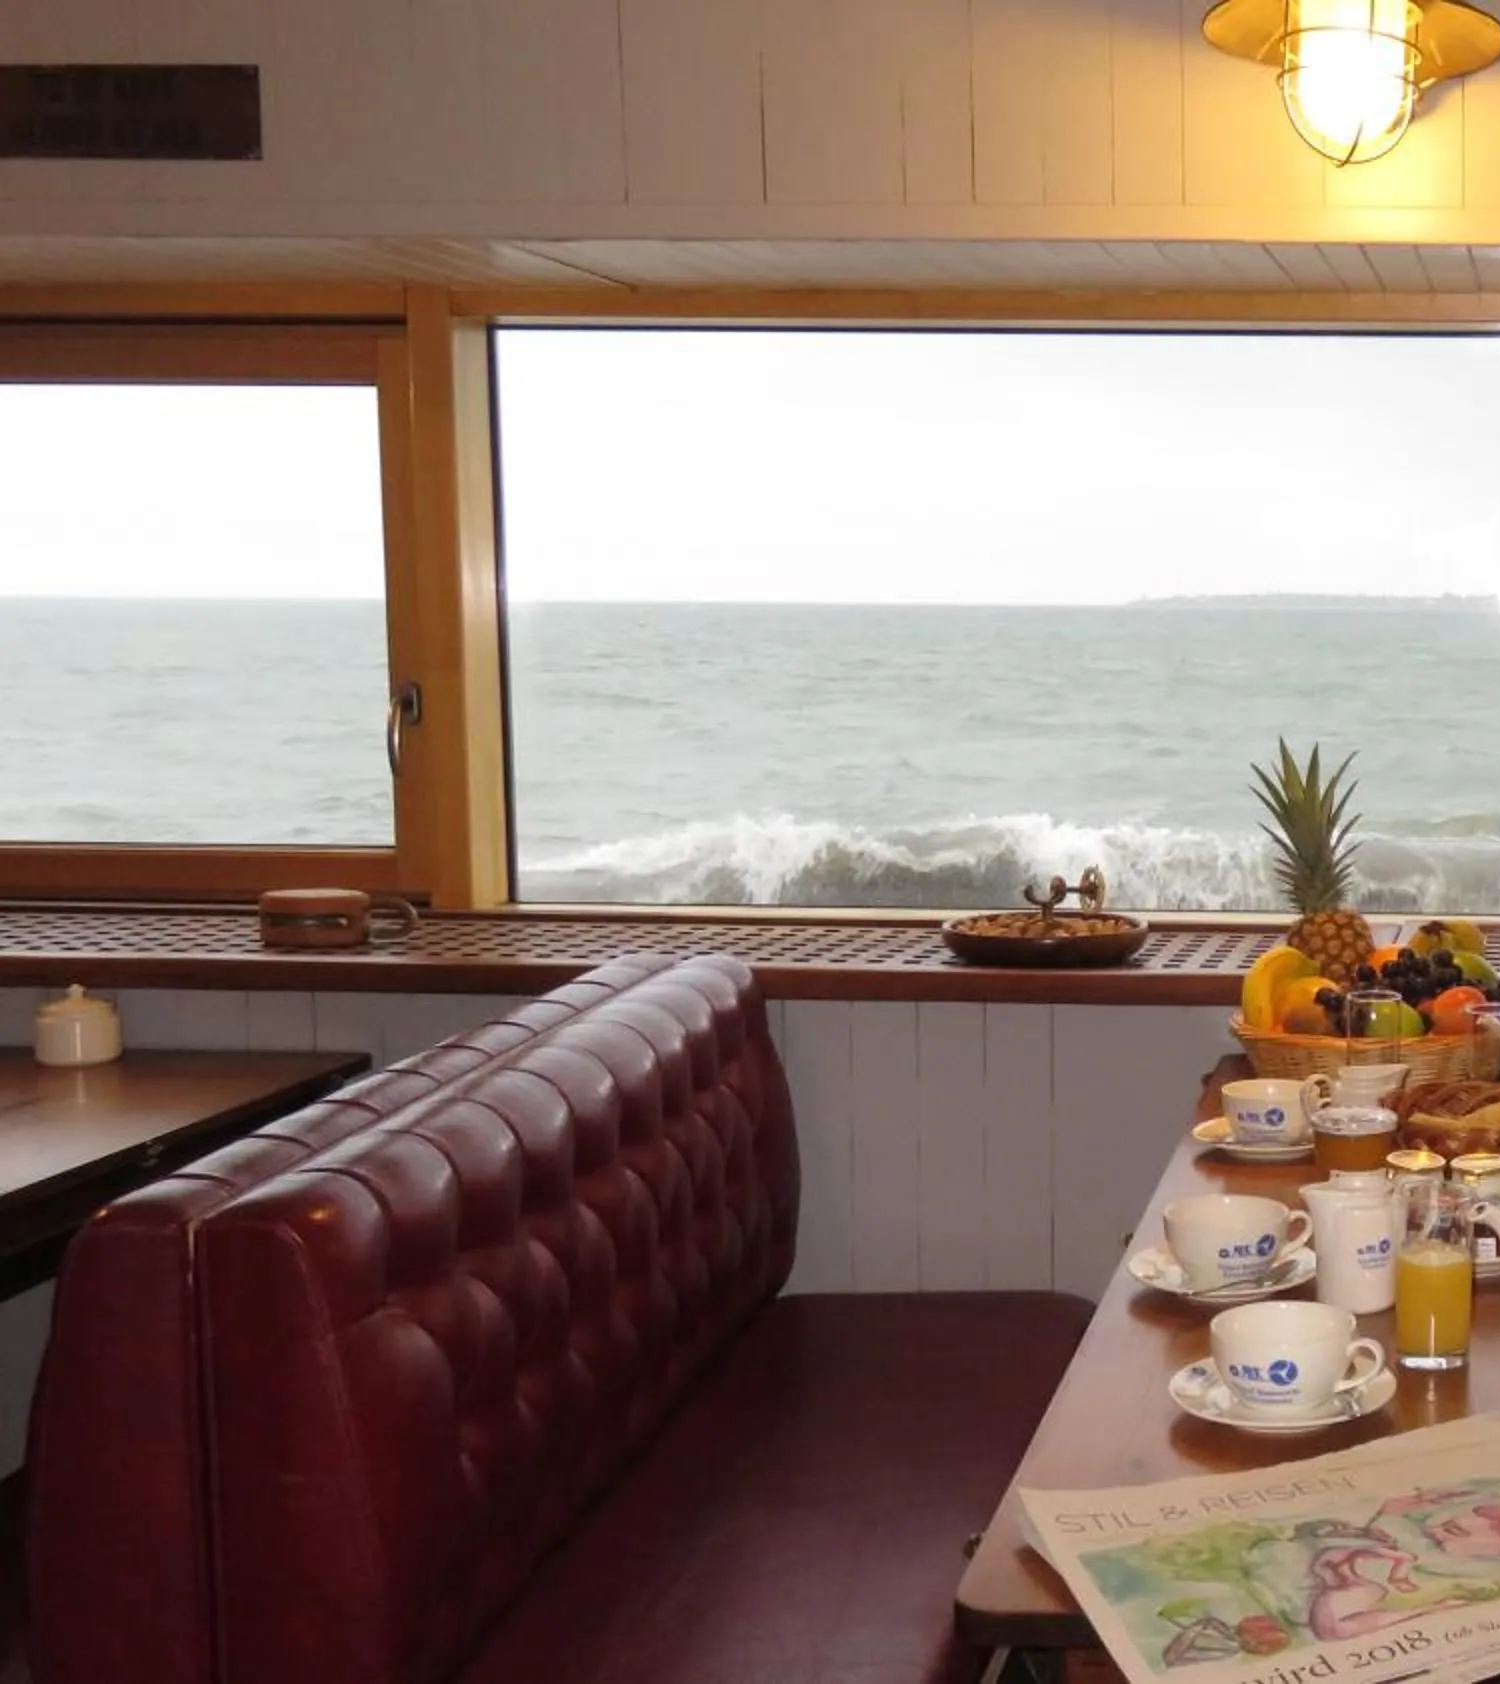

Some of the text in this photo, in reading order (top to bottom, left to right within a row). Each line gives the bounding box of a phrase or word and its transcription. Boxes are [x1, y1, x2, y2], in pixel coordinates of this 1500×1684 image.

[1055, 1475, 1356, 1534] STIL & REISEN
[1344, 1629, 1432, 1669] 2018
